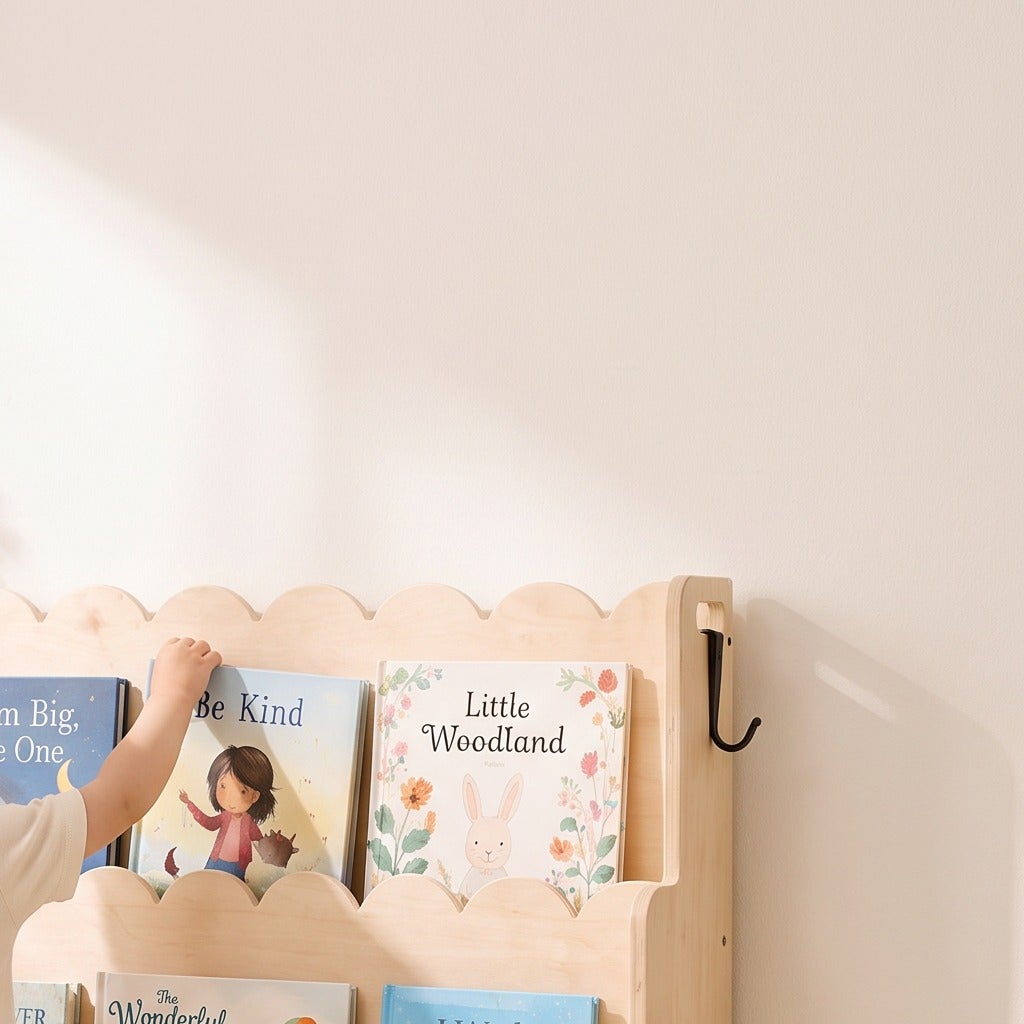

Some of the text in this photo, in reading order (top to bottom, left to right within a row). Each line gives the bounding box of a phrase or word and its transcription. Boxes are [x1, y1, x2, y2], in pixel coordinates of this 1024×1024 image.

[29, 699, 79, 735] Big,
[195, 690, 304, 727] Be Kind
[465, 691, 530, 719] Little
[14, 735, 64, 763] One
[421, 723, 566, 753] Woodland
[156, 989, 179, 1004] The
